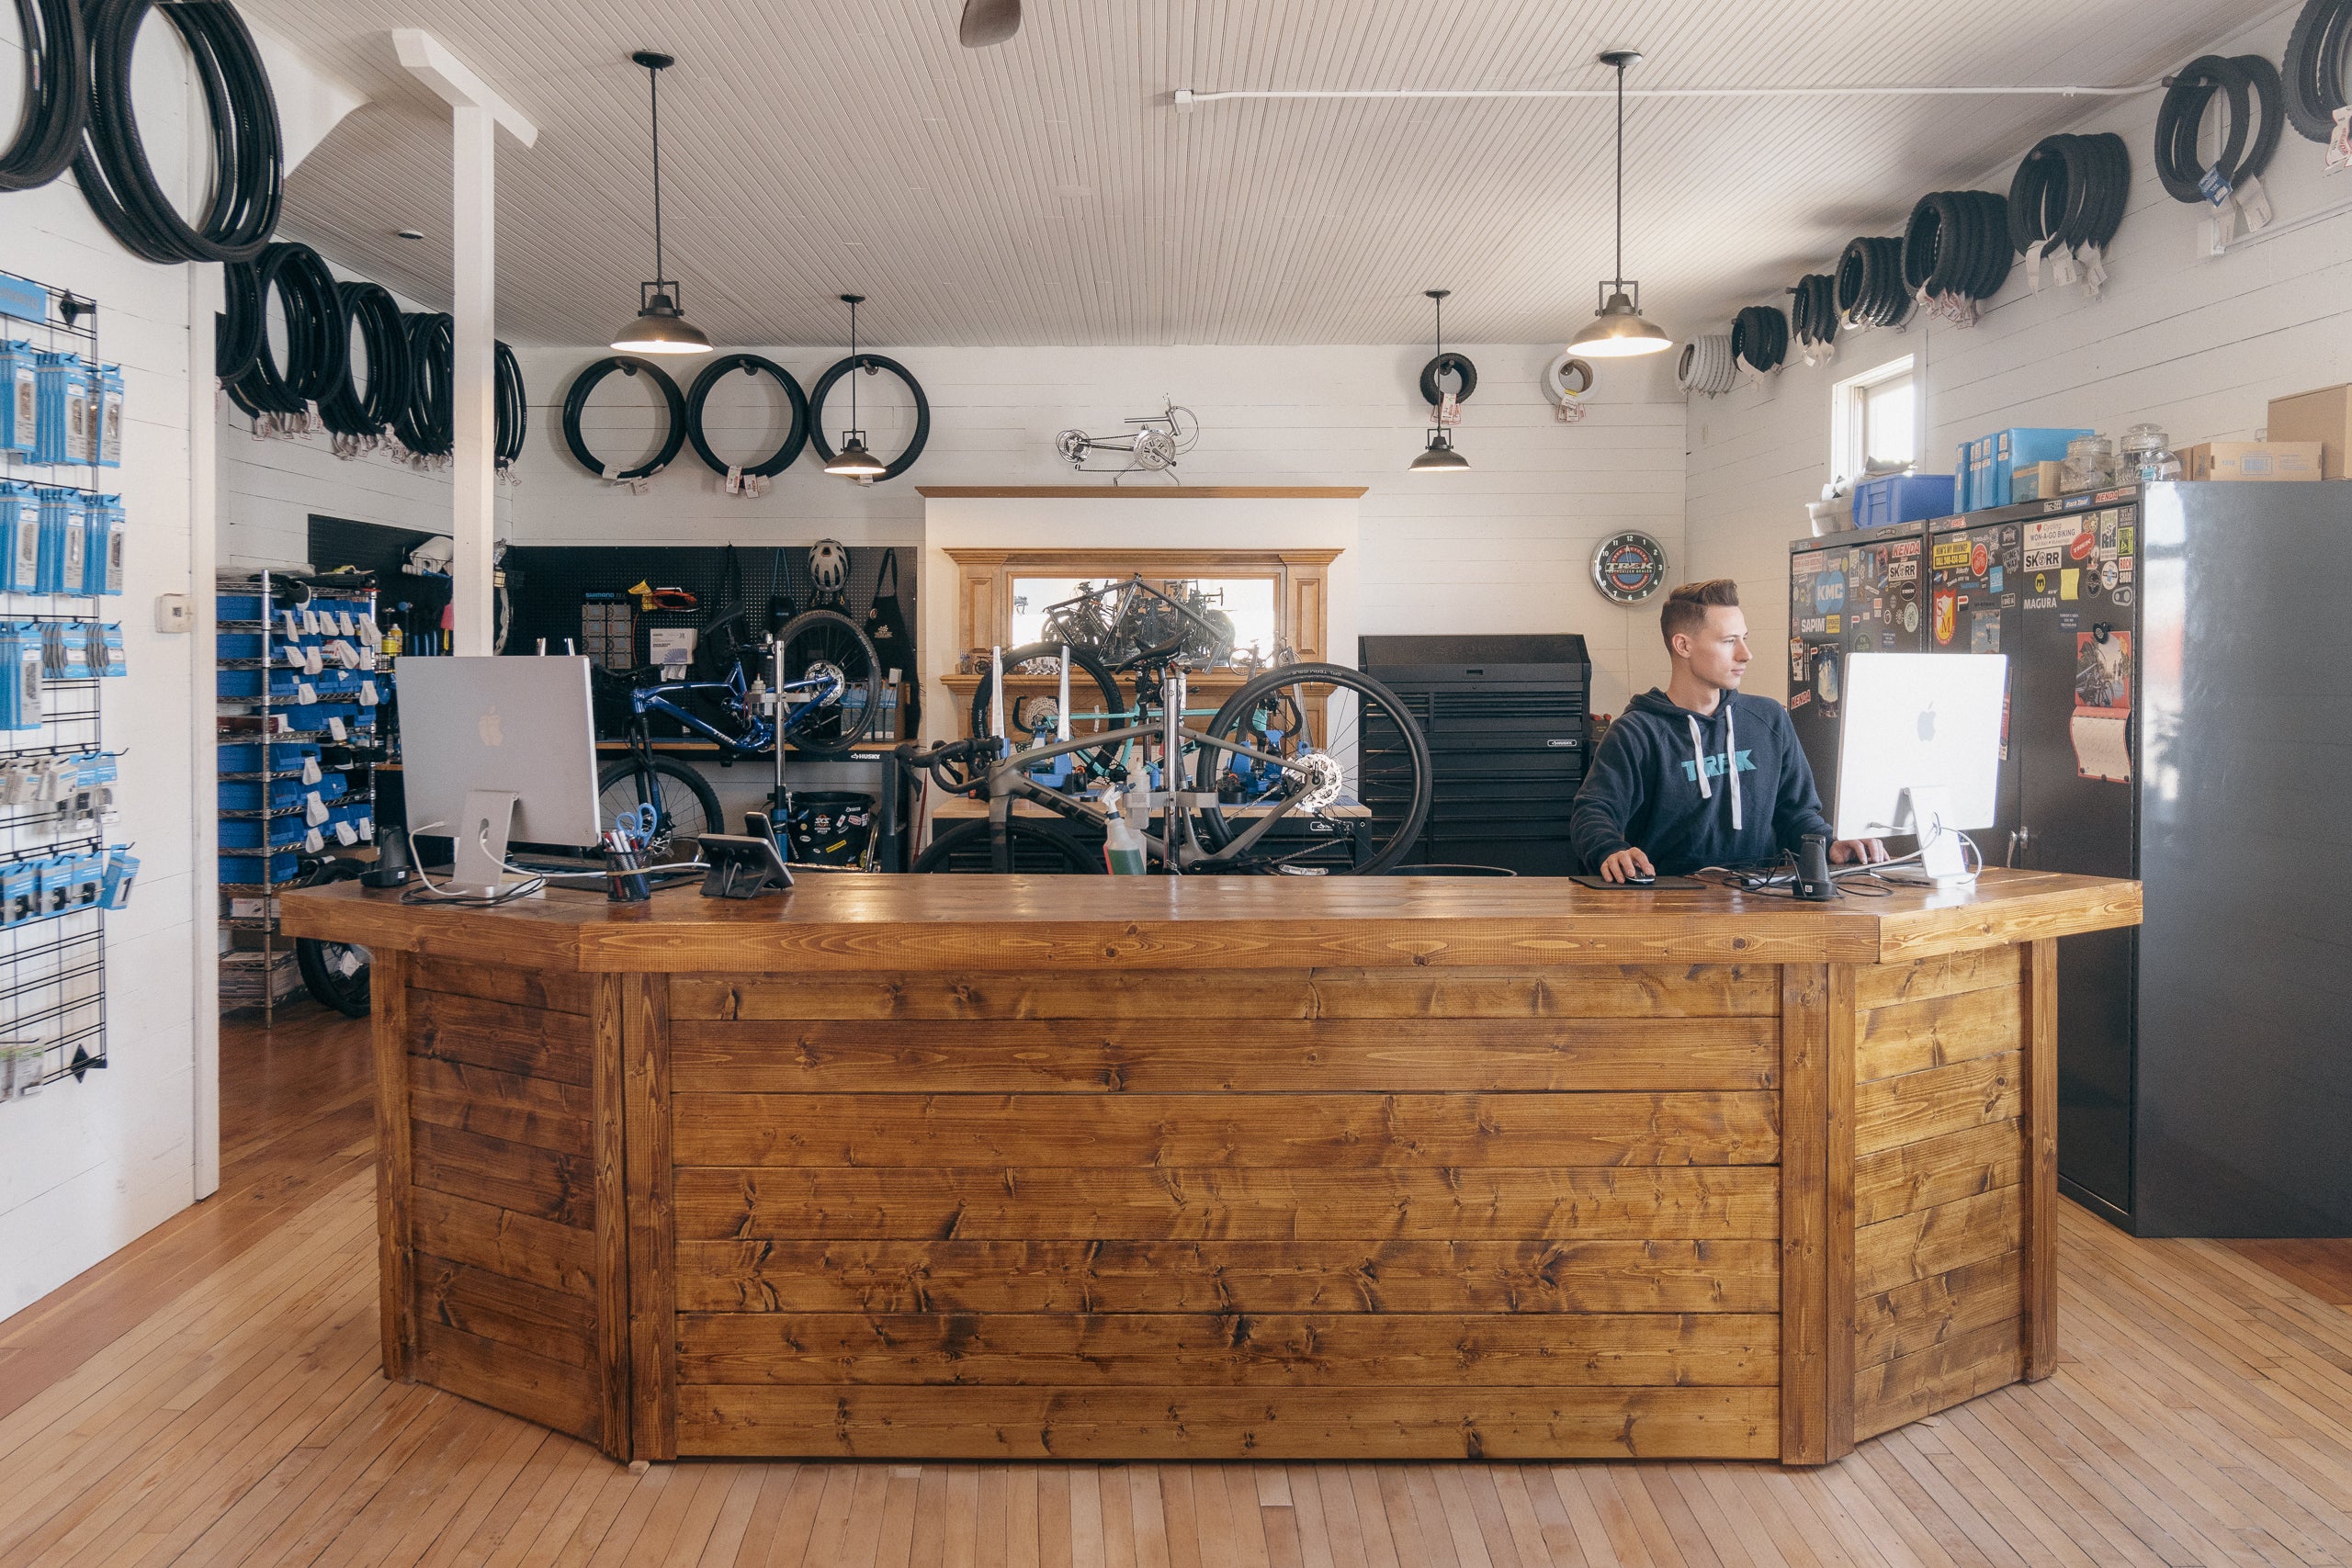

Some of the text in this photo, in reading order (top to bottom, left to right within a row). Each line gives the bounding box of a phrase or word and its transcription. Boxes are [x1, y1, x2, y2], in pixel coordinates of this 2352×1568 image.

[2096, 491, 2118, 502] KENDA
[2058, 528, 2075, 539] BIKING
[1893, 542, 1920, 556] KENDA
[2120, 558, 2132, 570] ROCK
[1816, 583, 1844, 601] KMC
[2023, 597, 2057, 610] MAGURA
[1801, 617, 1826, 633] SAPIM
[1940, 616, 1951, 634] M
[1680, 749, 1757, 782] TREK
